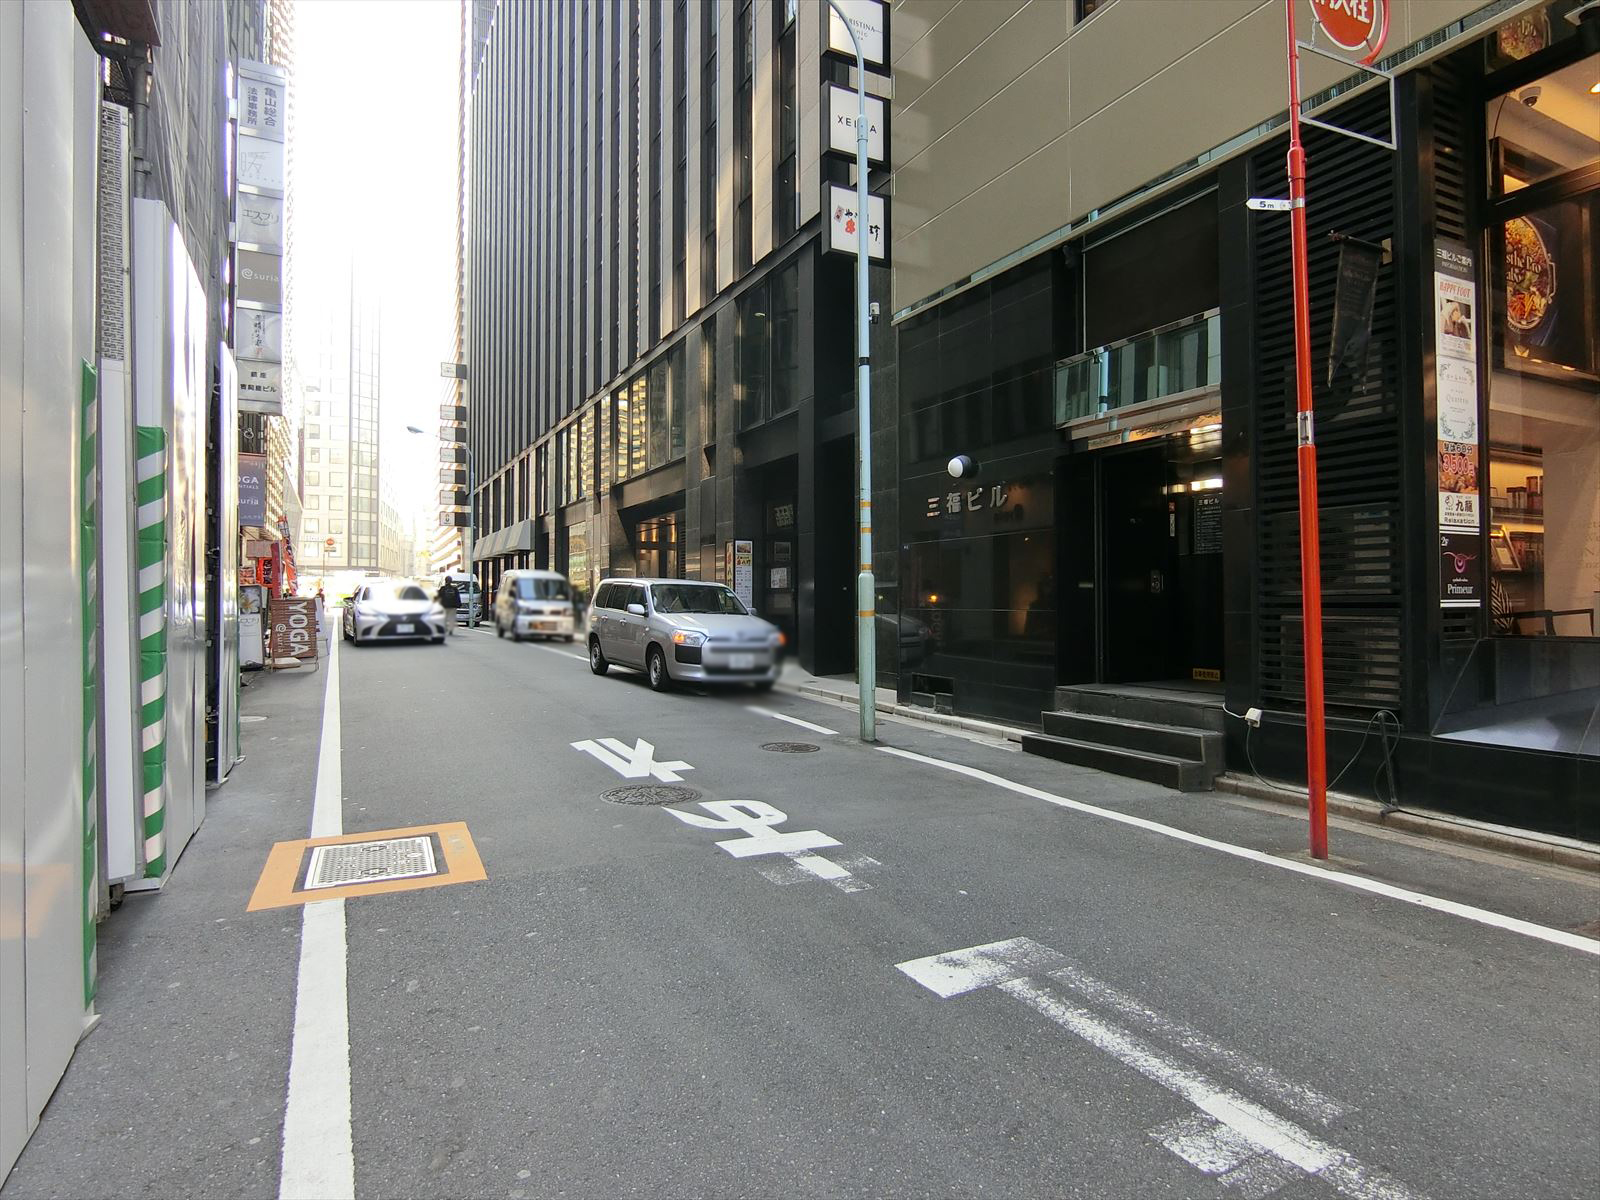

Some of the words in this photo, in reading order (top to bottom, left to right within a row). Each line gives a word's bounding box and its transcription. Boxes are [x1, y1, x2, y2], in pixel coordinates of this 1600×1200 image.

[926, 485, 1008, 518] 三福ビル
[288, 601, 310, 656] YOGA
